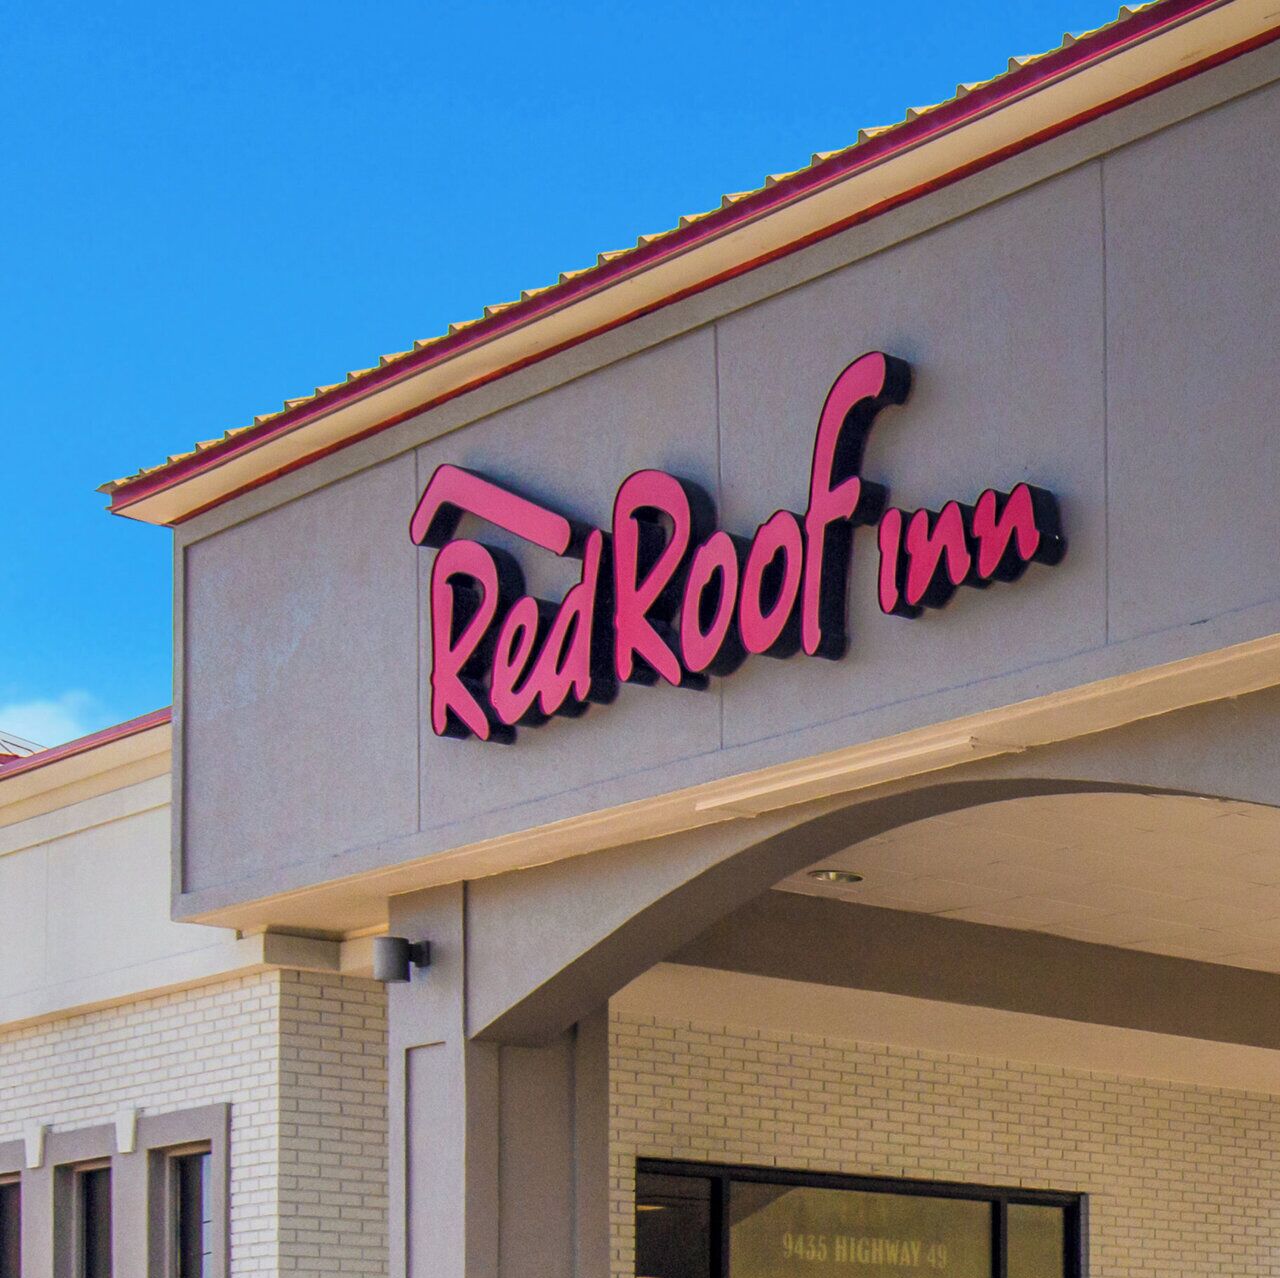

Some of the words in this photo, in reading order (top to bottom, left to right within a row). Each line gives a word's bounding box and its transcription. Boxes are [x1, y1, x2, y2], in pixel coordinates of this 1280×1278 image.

[430, 529, 606, 742] Red
[613, 350, 897, 688] Roof
[782, 1232, 828, 1262] 9435
[834, 1235, 922, 1267] HIGHWAY
[927, 1243, 948, 1269] 49
